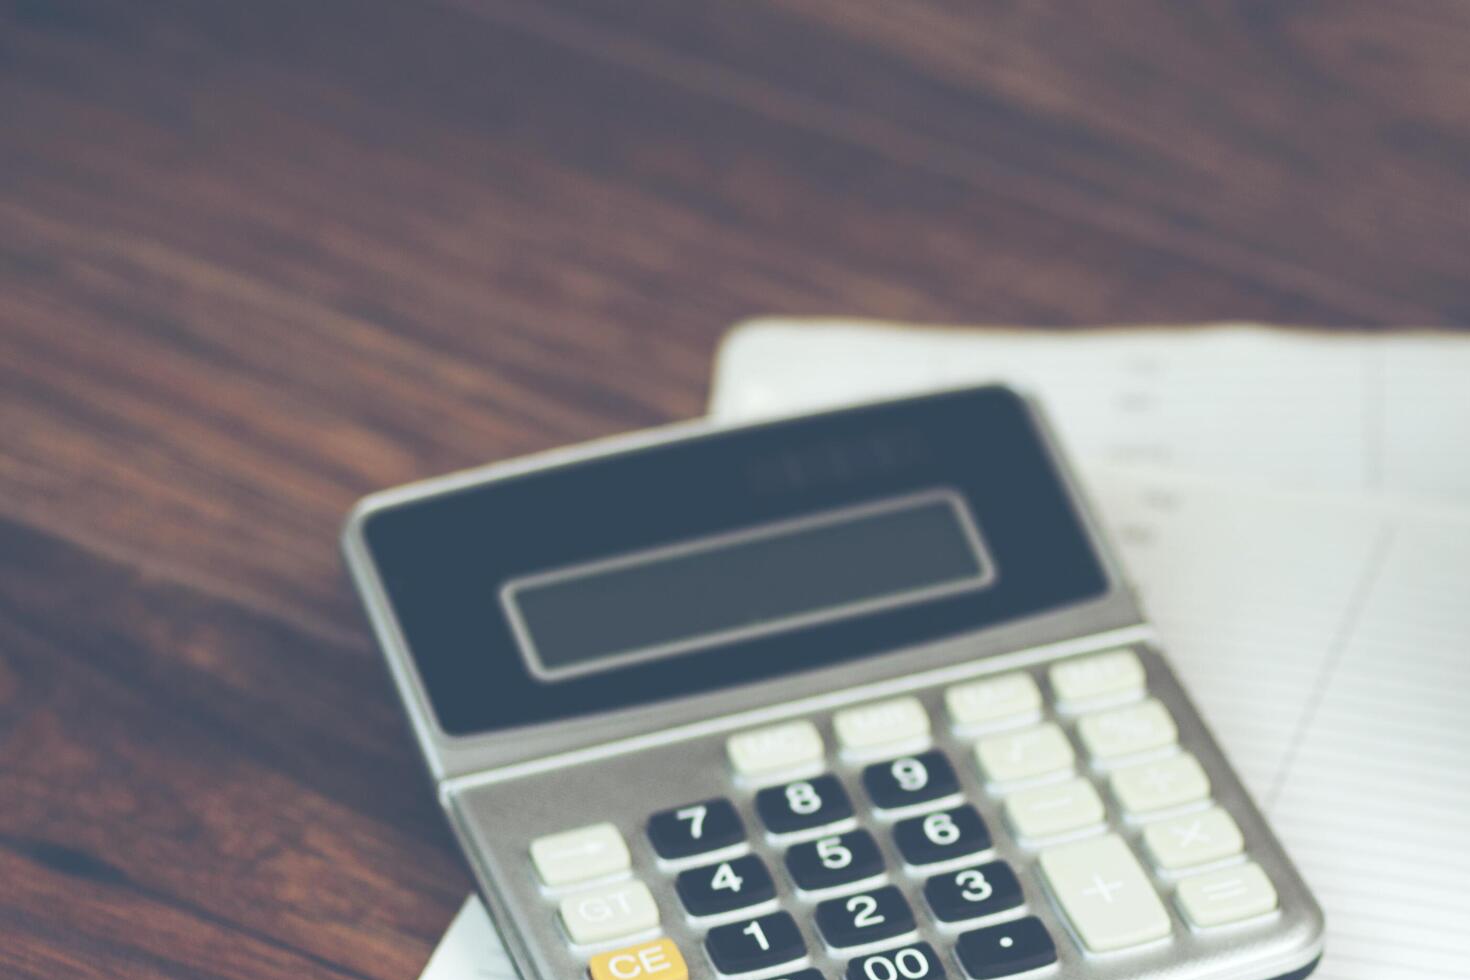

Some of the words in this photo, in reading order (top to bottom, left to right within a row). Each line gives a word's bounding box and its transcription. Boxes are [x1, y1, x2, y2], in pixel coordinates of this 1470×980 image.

[891, 758, 928, 791] 9
[785, 782, 822, 814] 8
[676, 806, 707, 839] 7
[924, 814, 960, 845] 6
[815, 838, 852, 869] 5
[711, 863, 743, 892] 4
[955, 870, 992, 901] 3
[847, 896, 885, 927] 2
[743, 921, 770, 951] 1
[608, 946, 671, 980] CE
